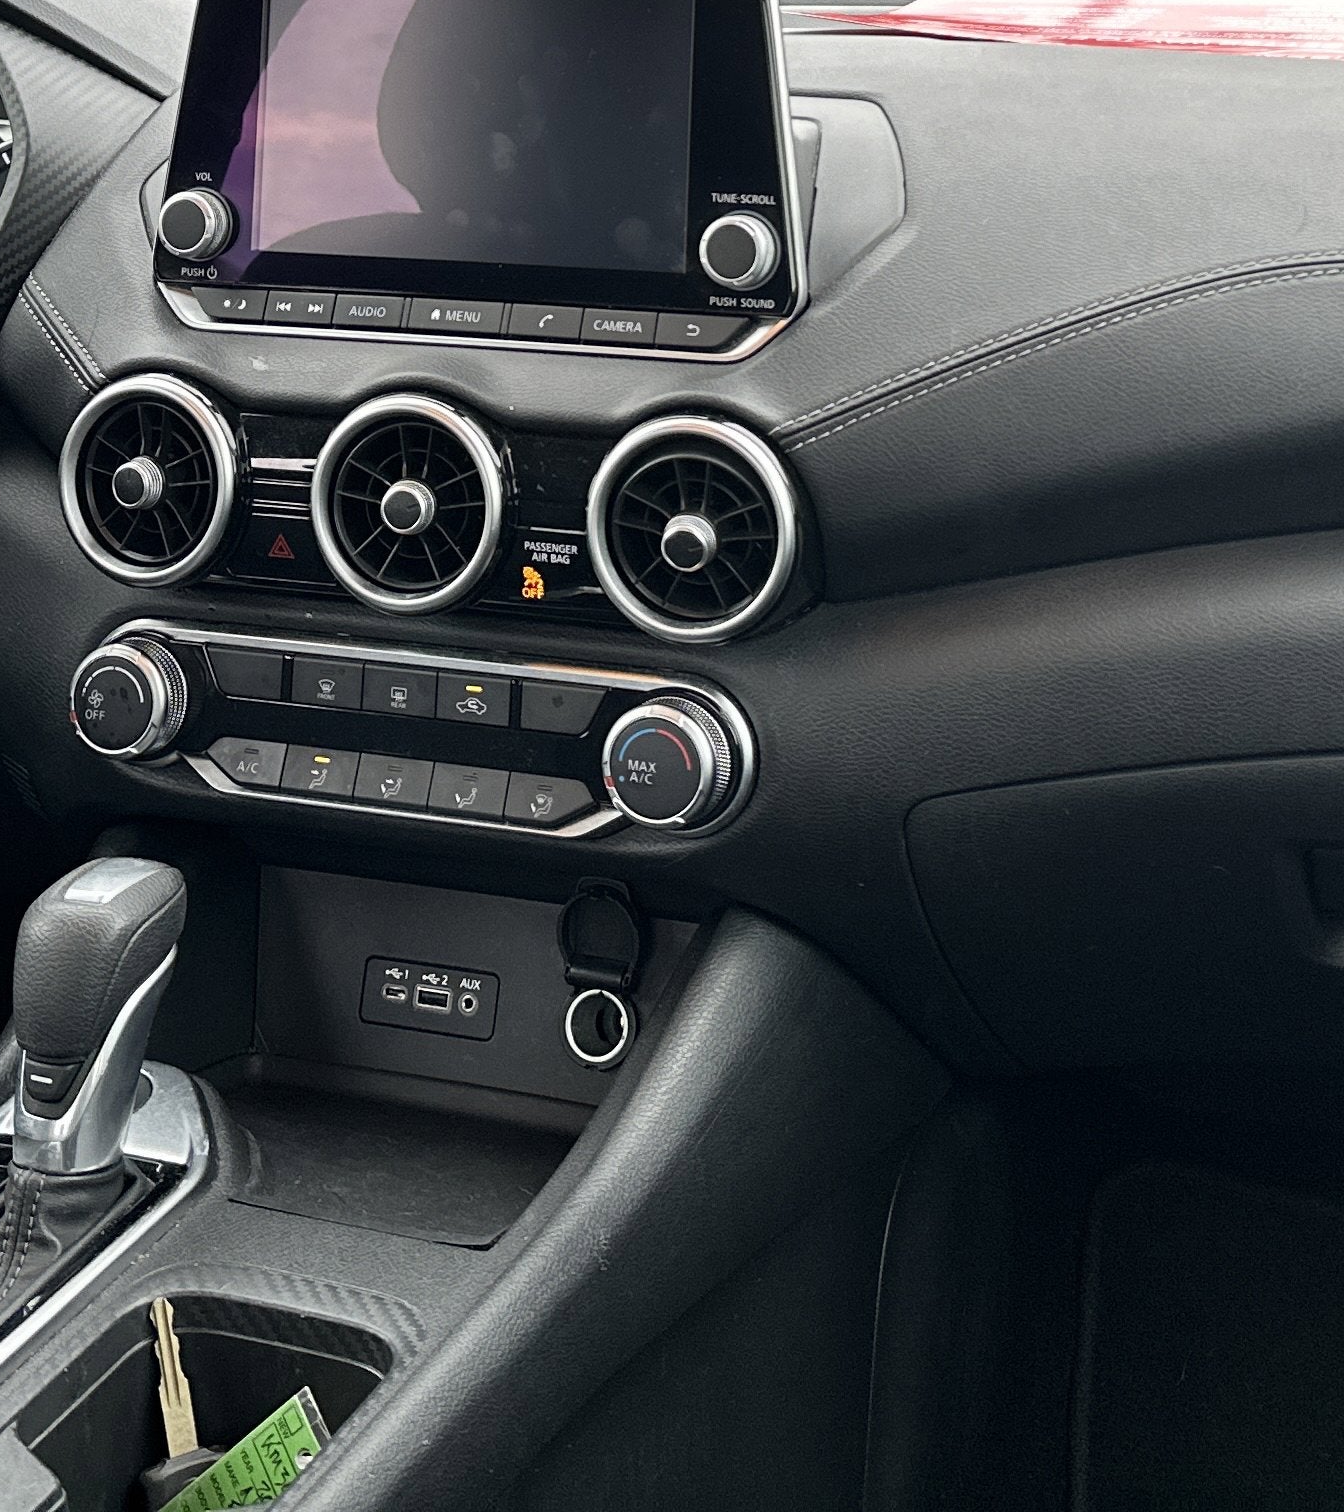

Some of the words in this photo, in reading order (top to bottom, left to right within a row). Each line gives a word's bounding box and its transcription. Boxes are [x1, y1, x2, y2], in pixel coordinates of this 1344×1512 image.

[194, 171, 213, 182] VOL
[180, 266, 206, 278] PUSH
[708, 296, 737, 309] PUSH
[739, 297, 776, 310] SOUND
[348, 305, 387, 319] AUDIO
[445, 309, 482, 324] MENU
[592, 318, 643, 334] CAMERA
[523, 539, 579, 558] PASSENGER
[530, 550, 548, 563] AIR
[549, 552, 572, 565] BAG
[521, 585, 546, 600] OFF
[84, 708, 106, 721] OFF
[236, 759, 258, 775] A/C
[627, 759, 657, 775] MAX
[628, 771, 654, 784] A/C
[460, 978, 481, 990] AUX
[276, 1417, 290, 1440] NEW
[239, 1449, 254, 1474] YEAR
[224, 1460, 240, 1487] MAKE
